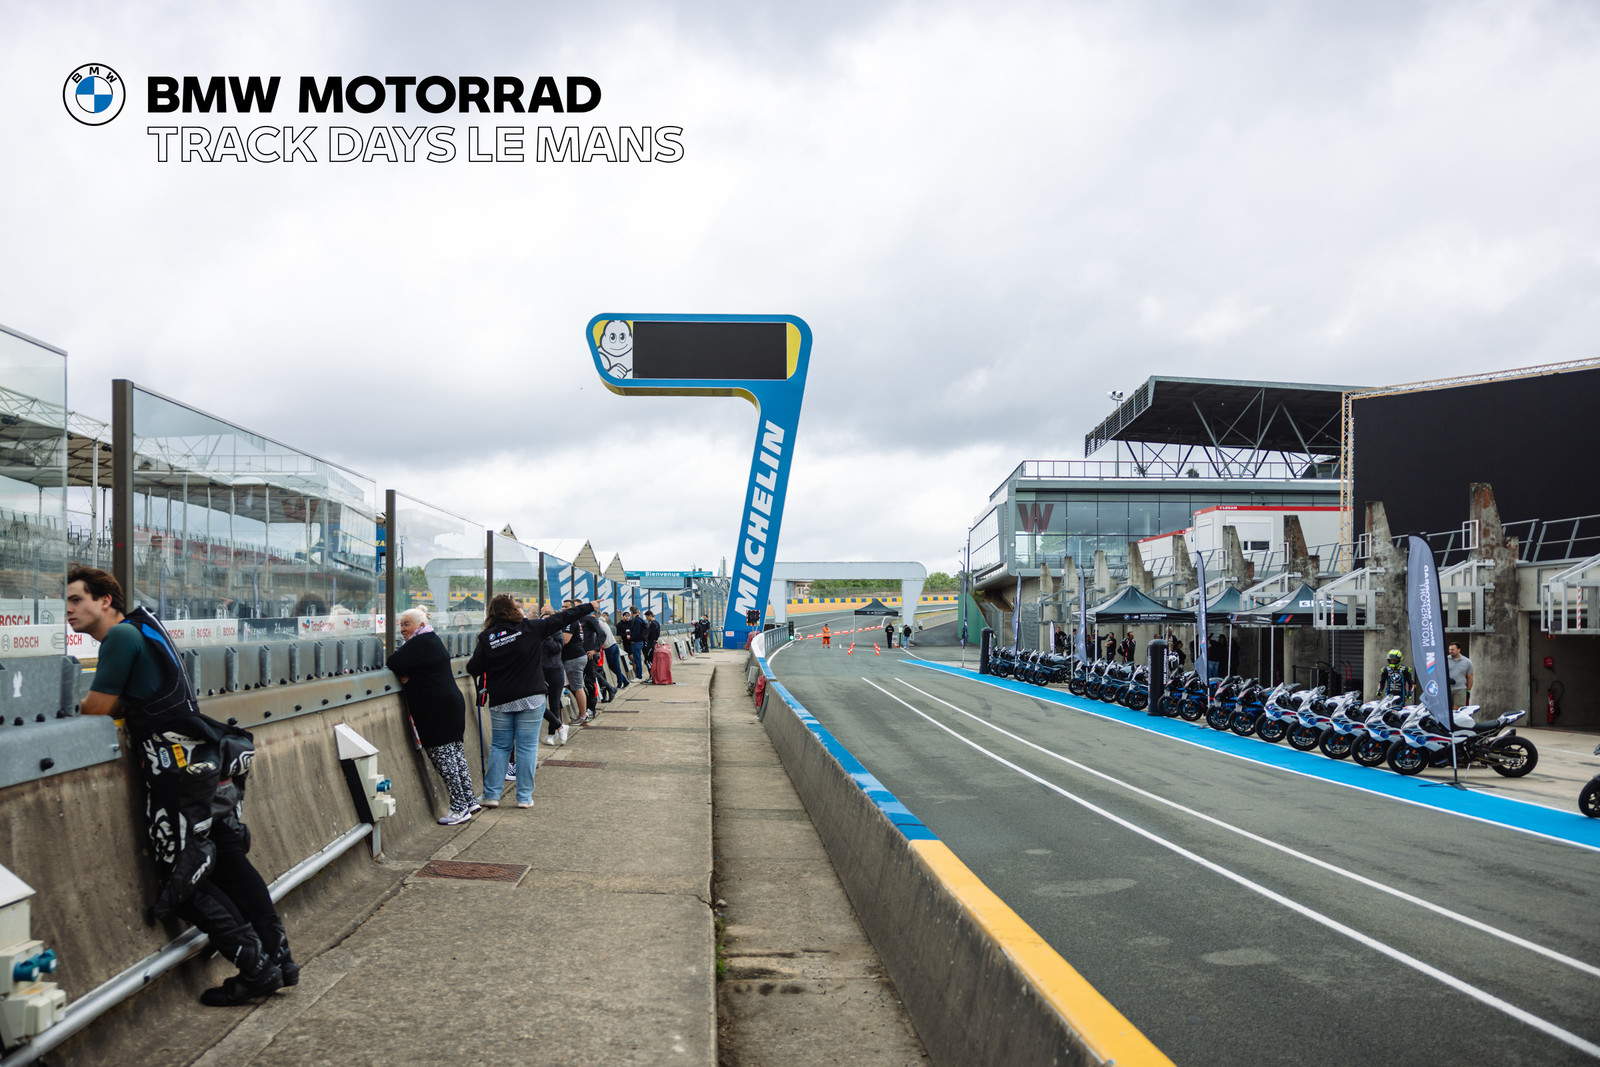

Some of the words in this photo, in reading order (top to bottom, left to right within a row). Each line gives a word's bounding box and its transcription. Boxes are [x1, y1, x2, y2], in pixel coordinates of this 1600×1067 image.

[734, 419, 785, 617] MICHELIN
[1017, 503, 1055, 532] W
[196, 628, 212, 638] BOSCH
[222, 627, 236, 637] BOSCH
[13, 636, 39, 649] BOSCH
[66, 634, 83, 646] OSCH
